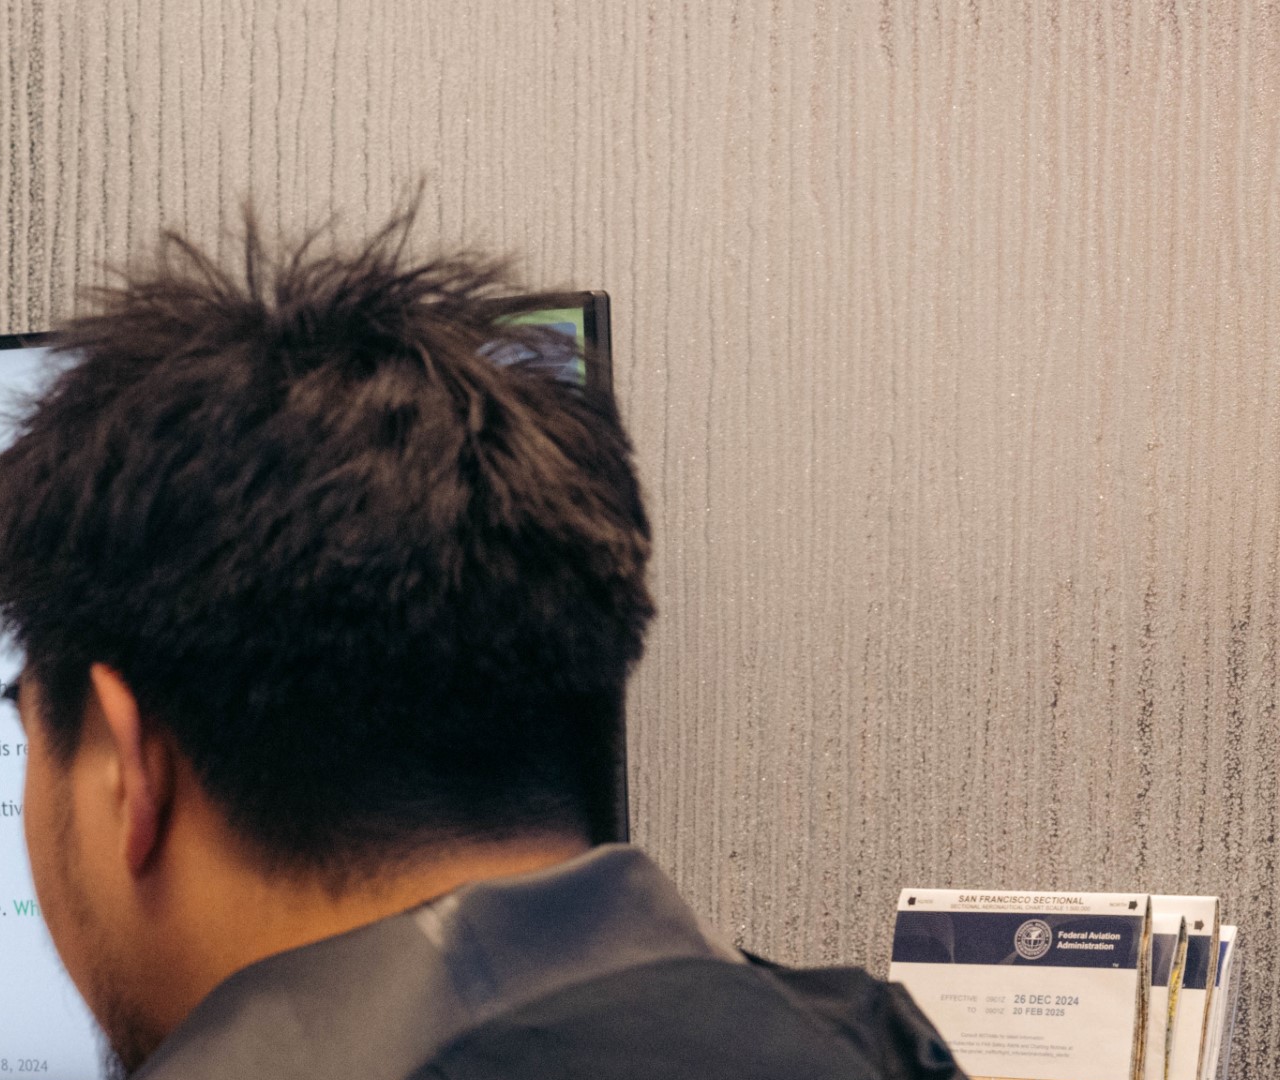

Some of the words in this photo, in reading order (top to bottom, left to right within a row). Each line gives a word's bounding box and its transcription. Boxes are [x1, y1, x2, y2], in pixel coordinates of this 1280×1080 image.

[959, 894, 976, 903] SAN
[978, 895, 1031, 905] FRANCISCO
[1033, 896, 1084, 905] SECTIONAL
[1058, 931, 1087, 940] Federal
[1090, 932, 1121, 940] Aviation
[1057, 941, 1114, 950] Administration
[1013, 994, 1026, 1004] 26
[1028, 995, 1051, 1005] DEC
[1055, 996, 1079, 1006] 2024
[967, 1006, 977, 1014] TO
[1012, 1007, 1023, 1015] 20
[1025, 1007, 1043, 1016] FEB
[1045, 1008, 1065, 1016] 2025
[1, 1059, 13, 1073] 8,
[18, 1059, 48, 1072] 2024
